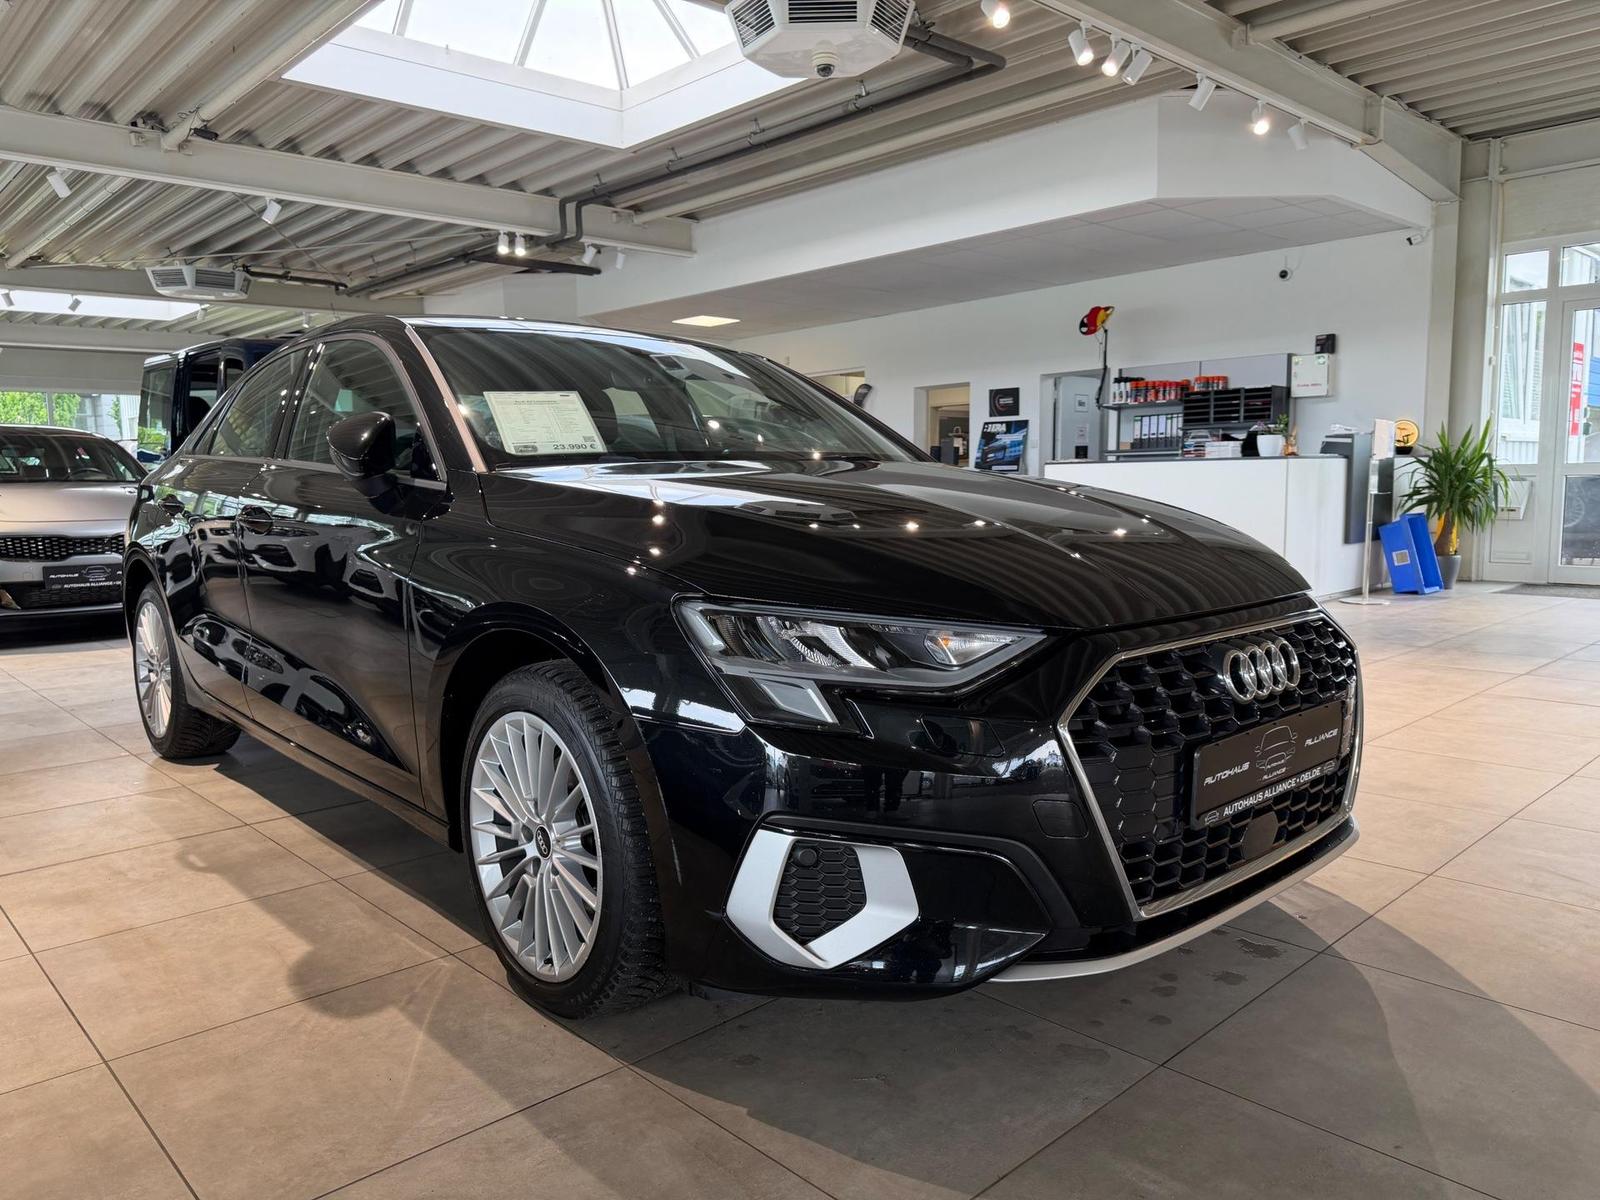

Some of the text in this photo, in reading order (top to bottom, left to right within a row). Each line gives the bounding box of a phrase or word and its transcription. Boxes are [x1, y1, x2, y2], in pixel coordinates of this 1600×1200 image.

[1203, 728, 1339, 786] AUTOHAUS ALLIANCE
[1223, 766, 1322, 817] AUTOHAUS ALLIANCE OELDE
